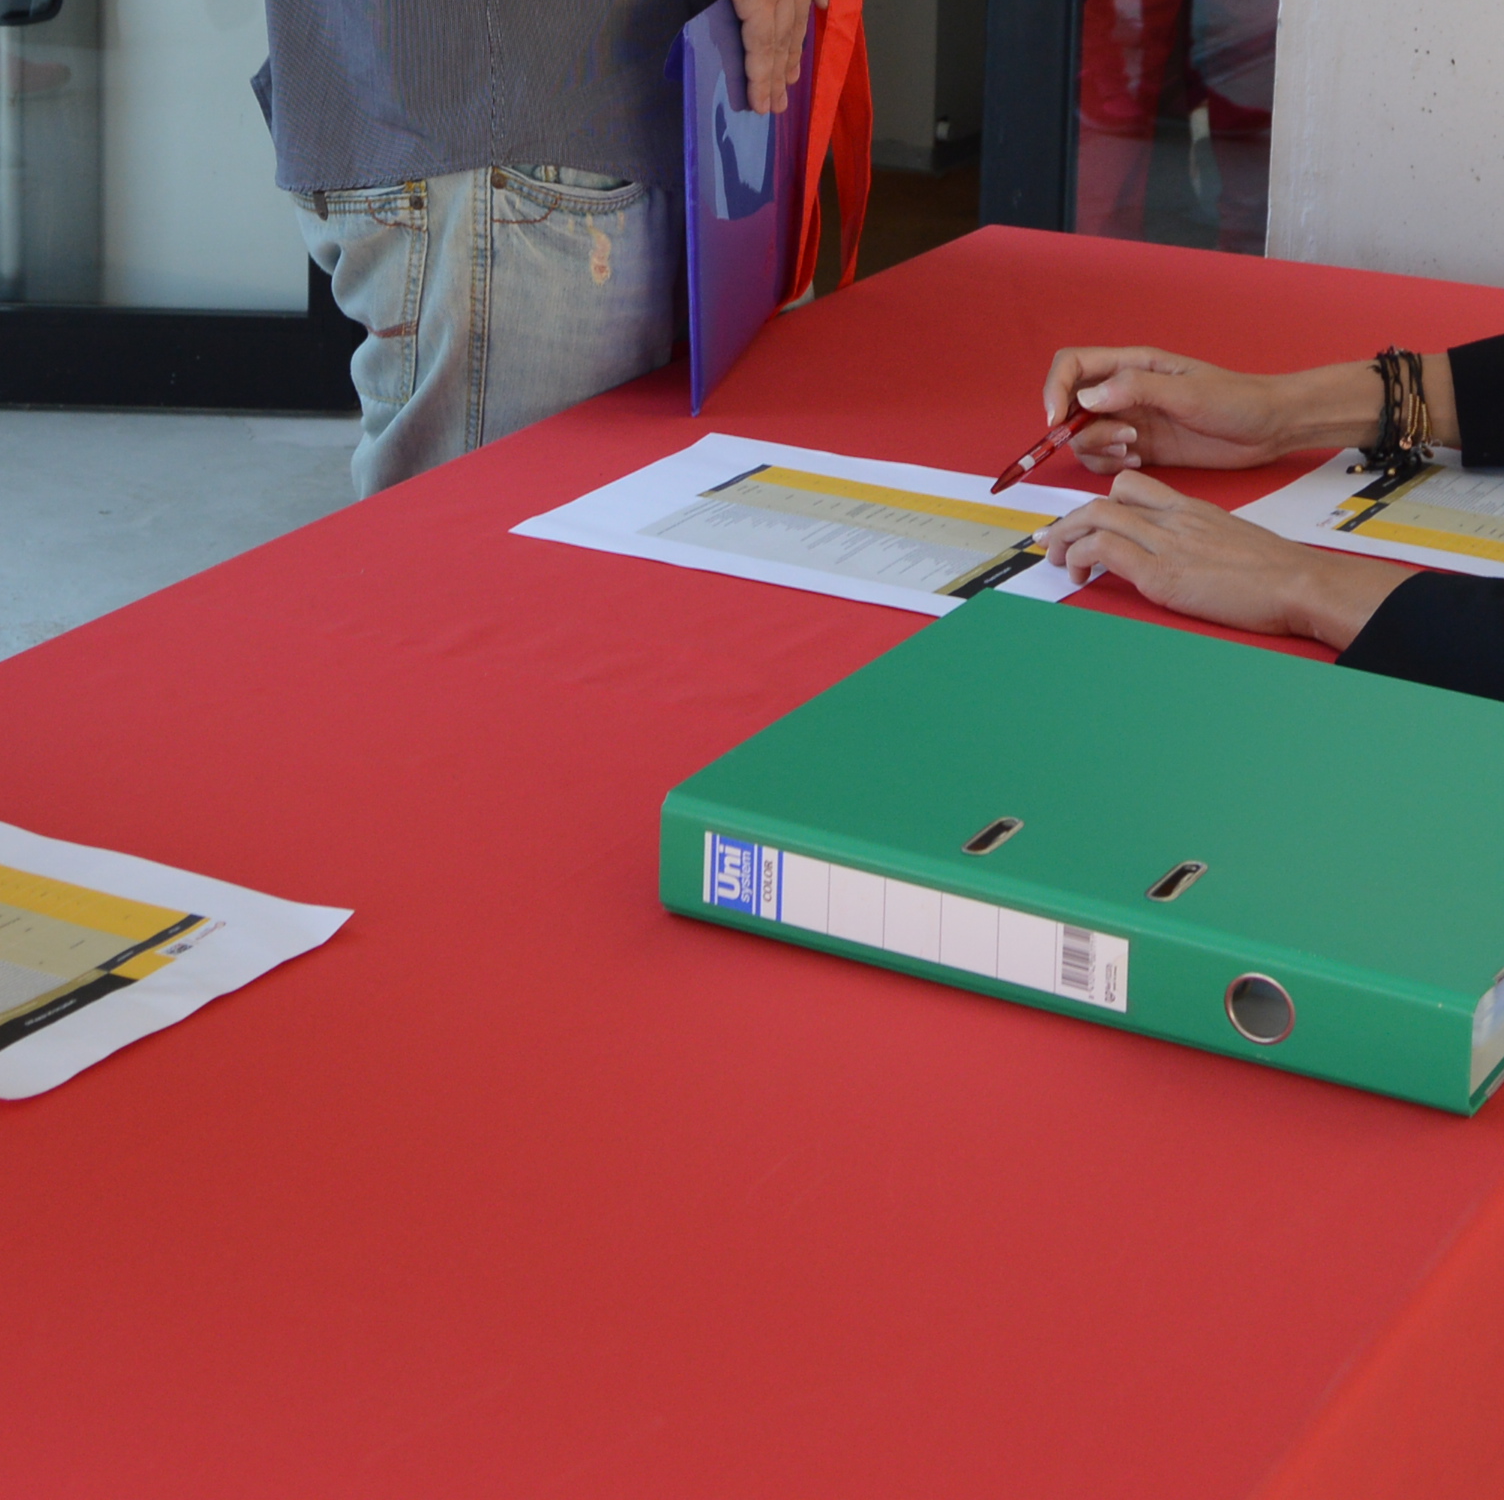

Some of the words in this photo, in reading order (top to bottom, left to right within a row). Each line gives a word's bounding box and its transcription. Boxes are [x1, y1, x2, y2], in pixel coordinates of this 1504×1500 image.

[716, 844, 742, 901] Uni
[740, 850, 754, 904] system
[762, 860, 773, 903] COLOR
